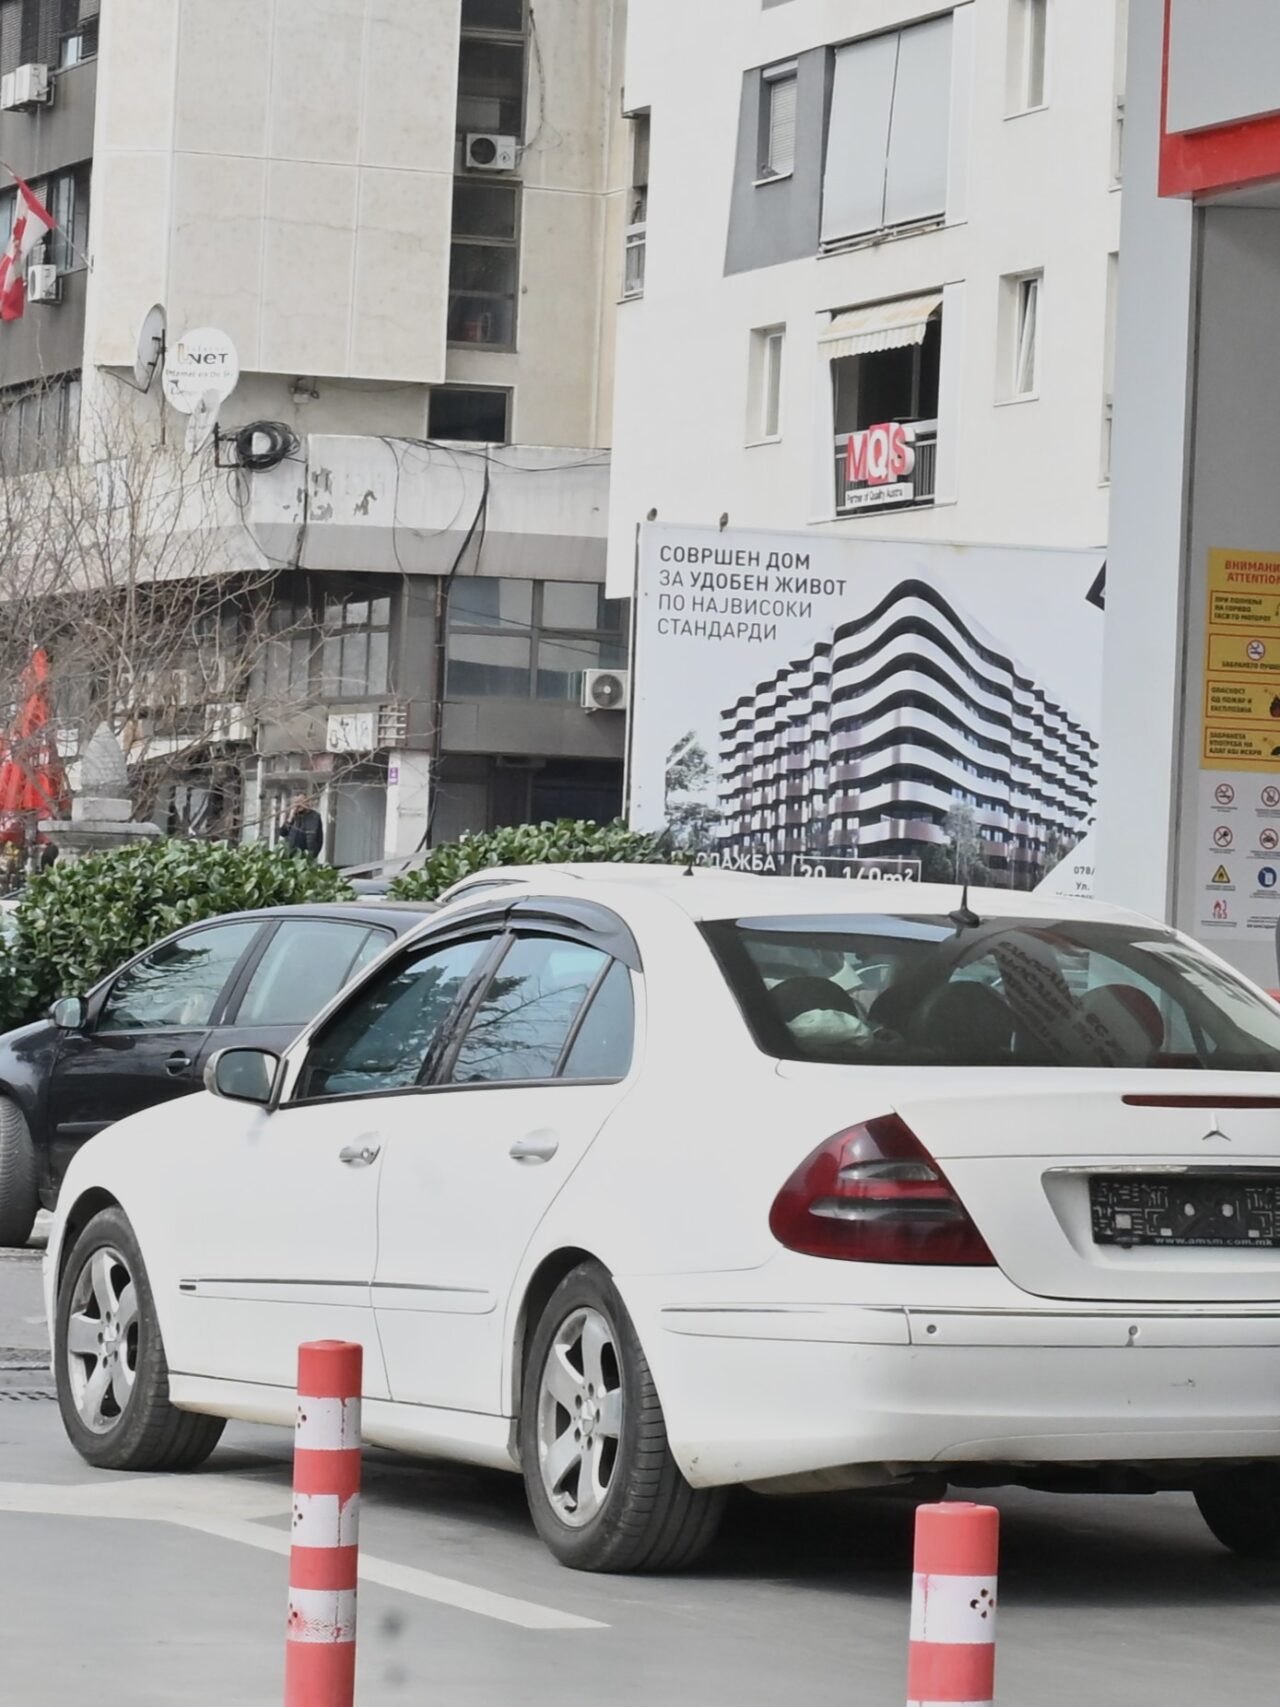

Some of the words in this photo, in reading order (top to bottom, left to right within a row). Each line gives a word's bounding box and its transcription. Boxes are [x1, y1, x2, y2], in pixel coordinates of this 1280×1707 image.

[847, 424, 910, 481] MQS
[660, 545, 760, 567] СОВРШЕН
[766, 551, 810, 571] ДОМ
[659, 569, 684, 587] ЗА
[690, 571, 769, 592] УДОБЕН
[775, 576, 847, 596] ЖИВОТ
[658, 593, 685, 612] ПО
[692, 595, 812, 618] НАЈВИСОКИ
[657, 617, 777, 643] СТАНДАРДИ
[1154, 1237, 1273, 1246] www.amsm.com.mk
